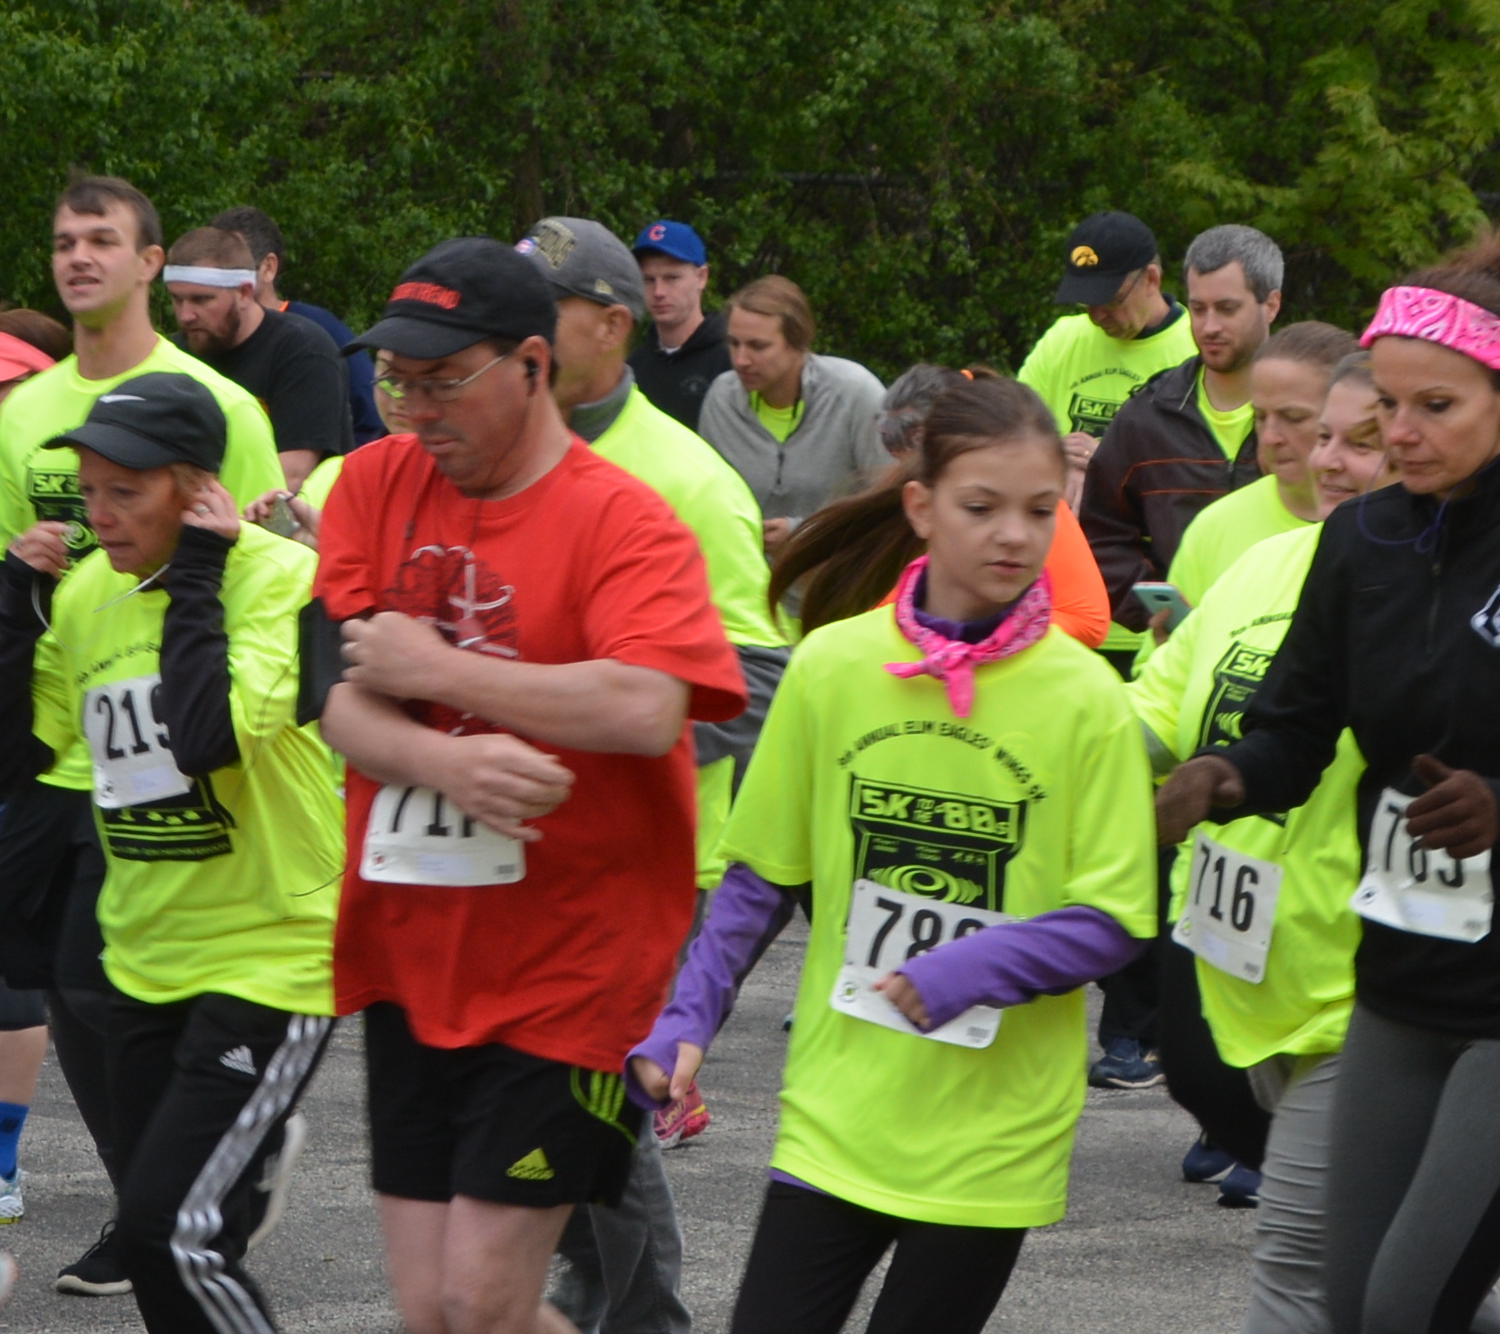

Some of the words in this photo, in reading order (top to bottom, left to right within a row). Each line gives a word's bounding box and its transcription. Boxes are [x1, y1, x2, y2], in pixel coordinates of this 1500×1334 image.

[649, 224, 666, 241] C
[861, 789, 915, 819] 5K
[1195, 843, 1260, 932] 716
